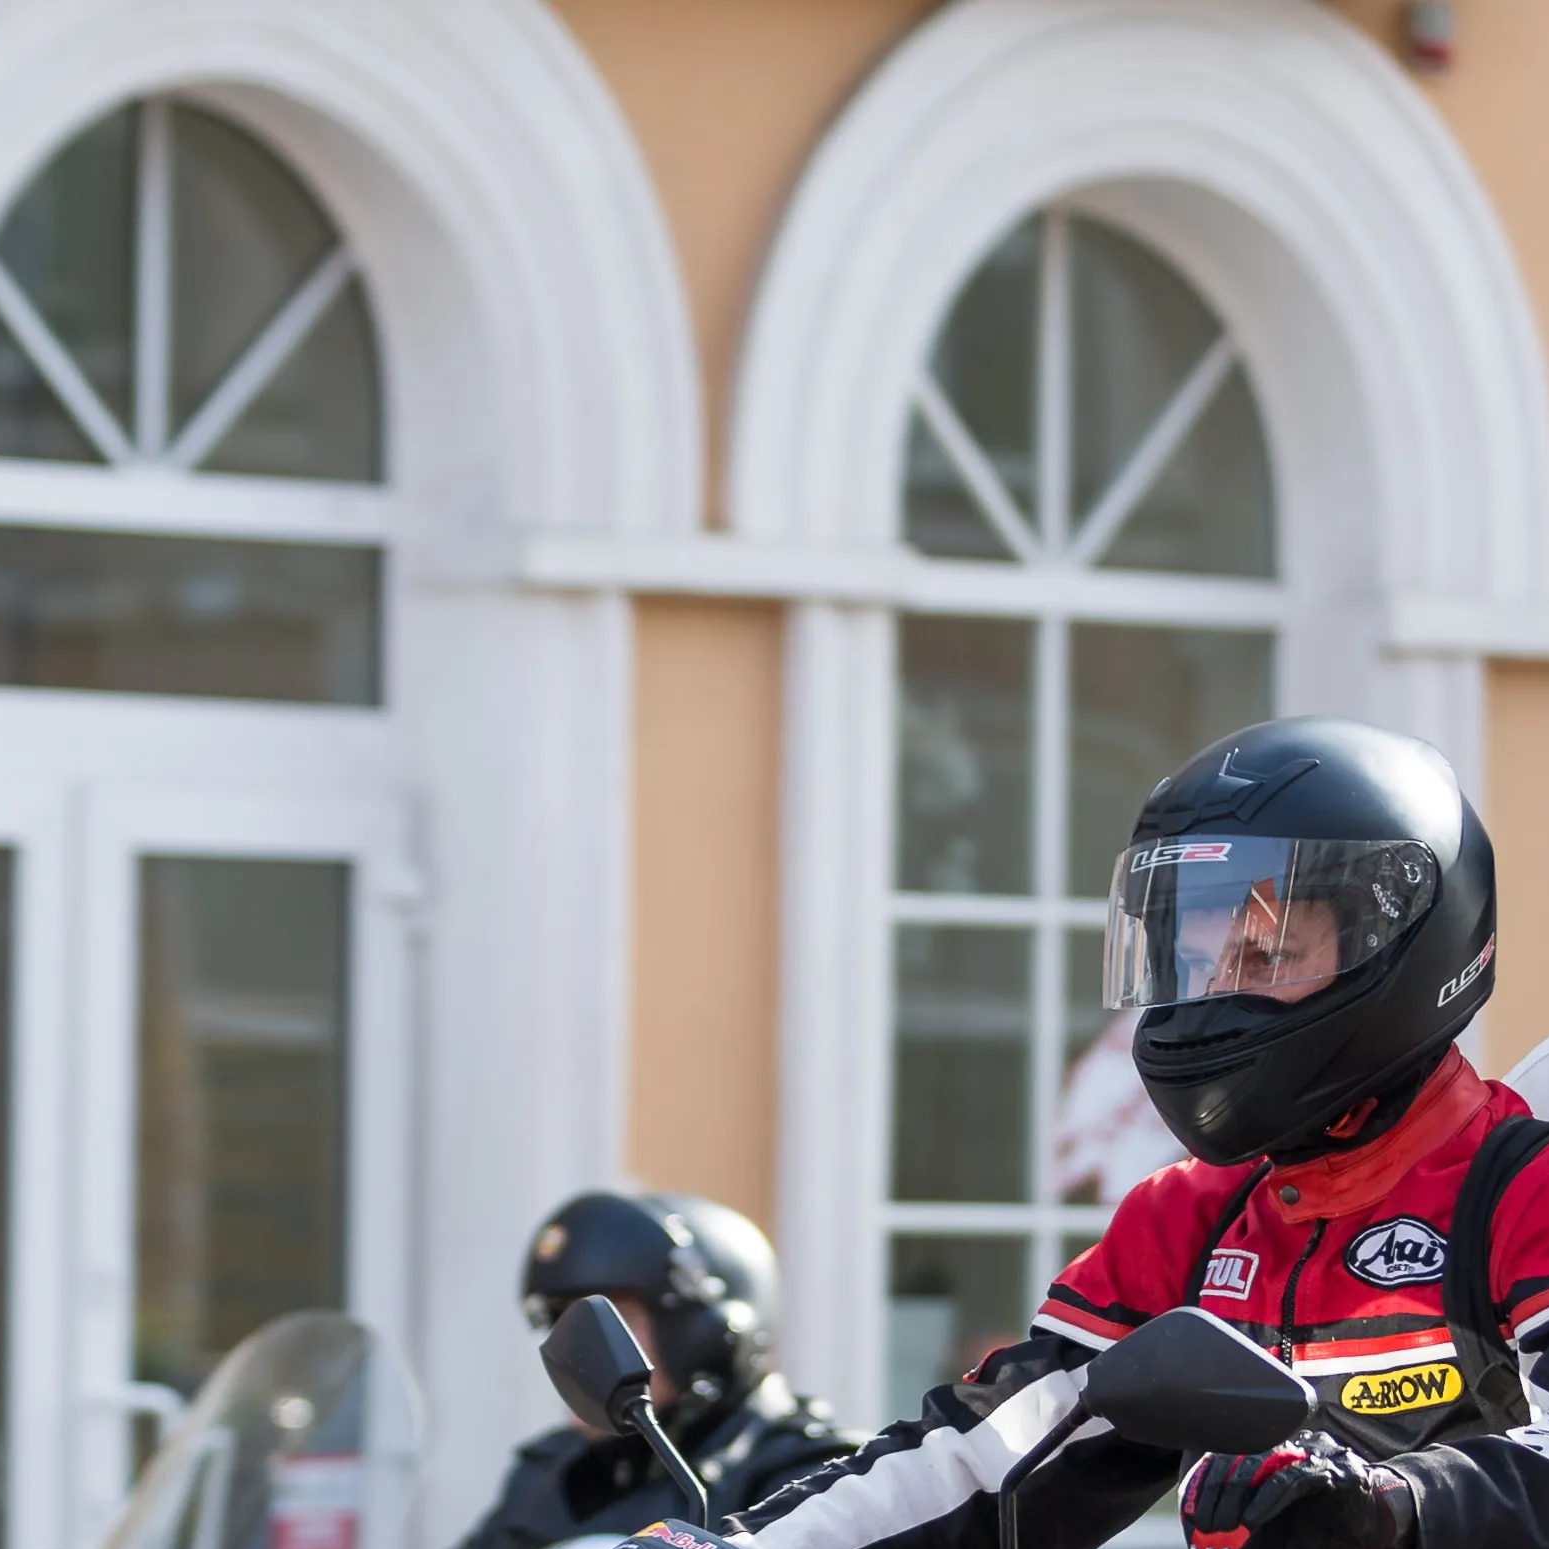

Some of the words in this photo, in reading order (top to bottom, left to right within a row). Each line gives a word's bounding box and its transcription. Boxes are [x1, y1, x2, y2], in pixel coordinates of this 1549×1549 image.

[1131, 843, 1232, 873] LS2
[1356, 1228, 1440, 1267] Arai
[1204, 1257, 1246, 1290] TUL
[1350, 1368, 1449, 1409] ARROW
